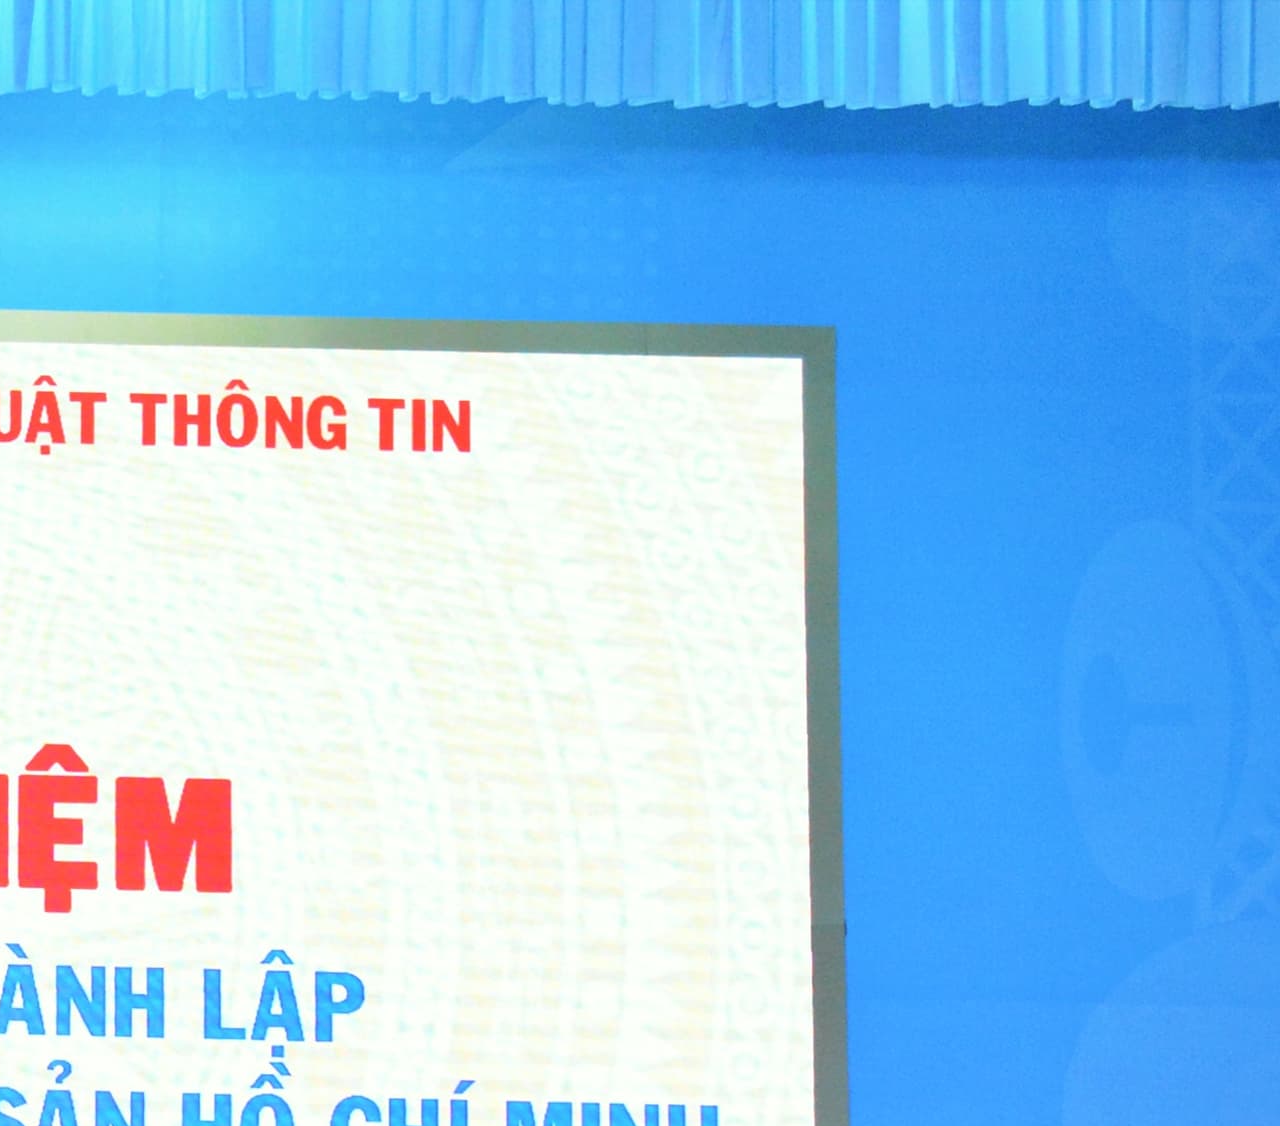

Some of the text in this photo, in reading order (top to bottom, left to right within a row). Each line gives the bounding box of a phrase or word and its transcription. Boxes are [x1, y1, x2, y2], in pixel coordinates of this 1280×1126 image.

[130, 379, 346, 450] THÔNG
[368, 398, 471, 452] TIN
[203, 949, 365, 1058] LẬP
